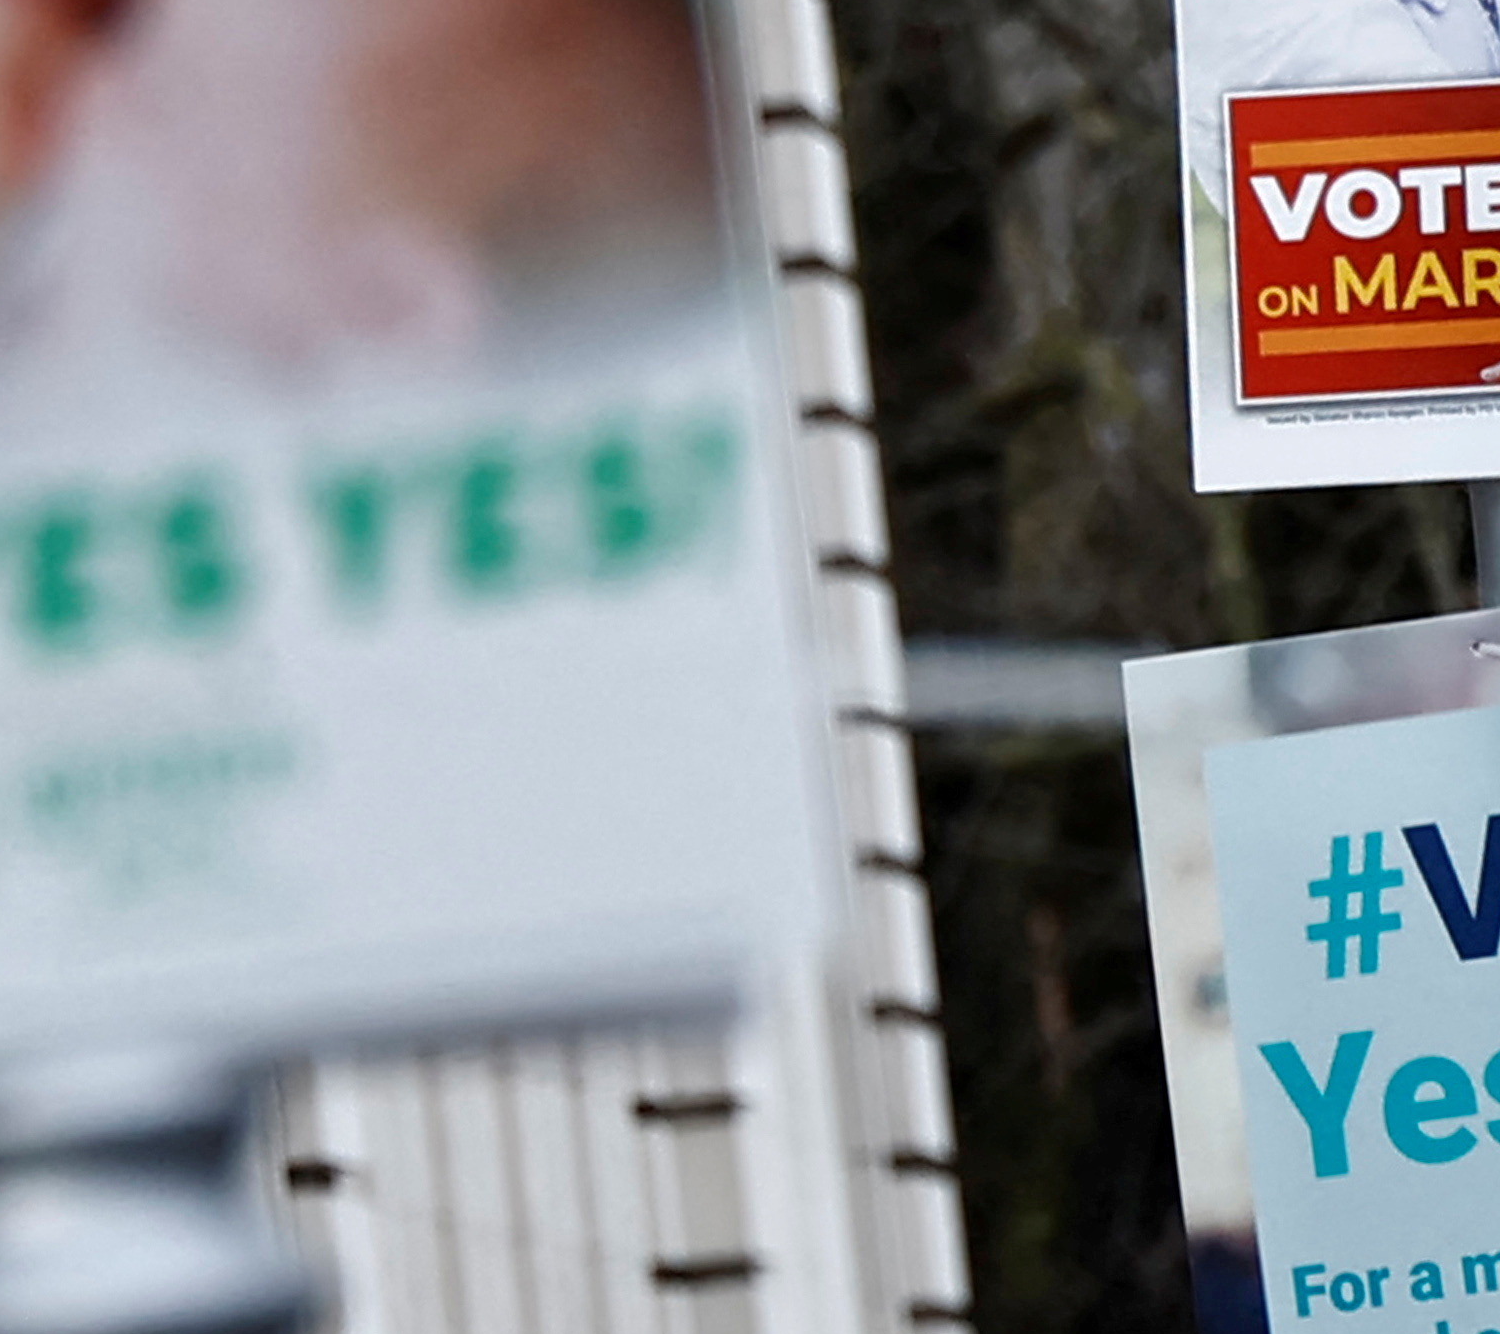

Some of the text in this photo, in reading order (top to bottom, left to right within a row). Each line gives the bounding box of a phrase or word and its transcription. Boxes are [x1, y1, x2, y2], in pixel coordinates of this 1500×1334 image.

[1259, 285, 1319, 319] ON
[1292, 1263, 1392, 1317] For
[1409, 1261, 1445, 1301] a
